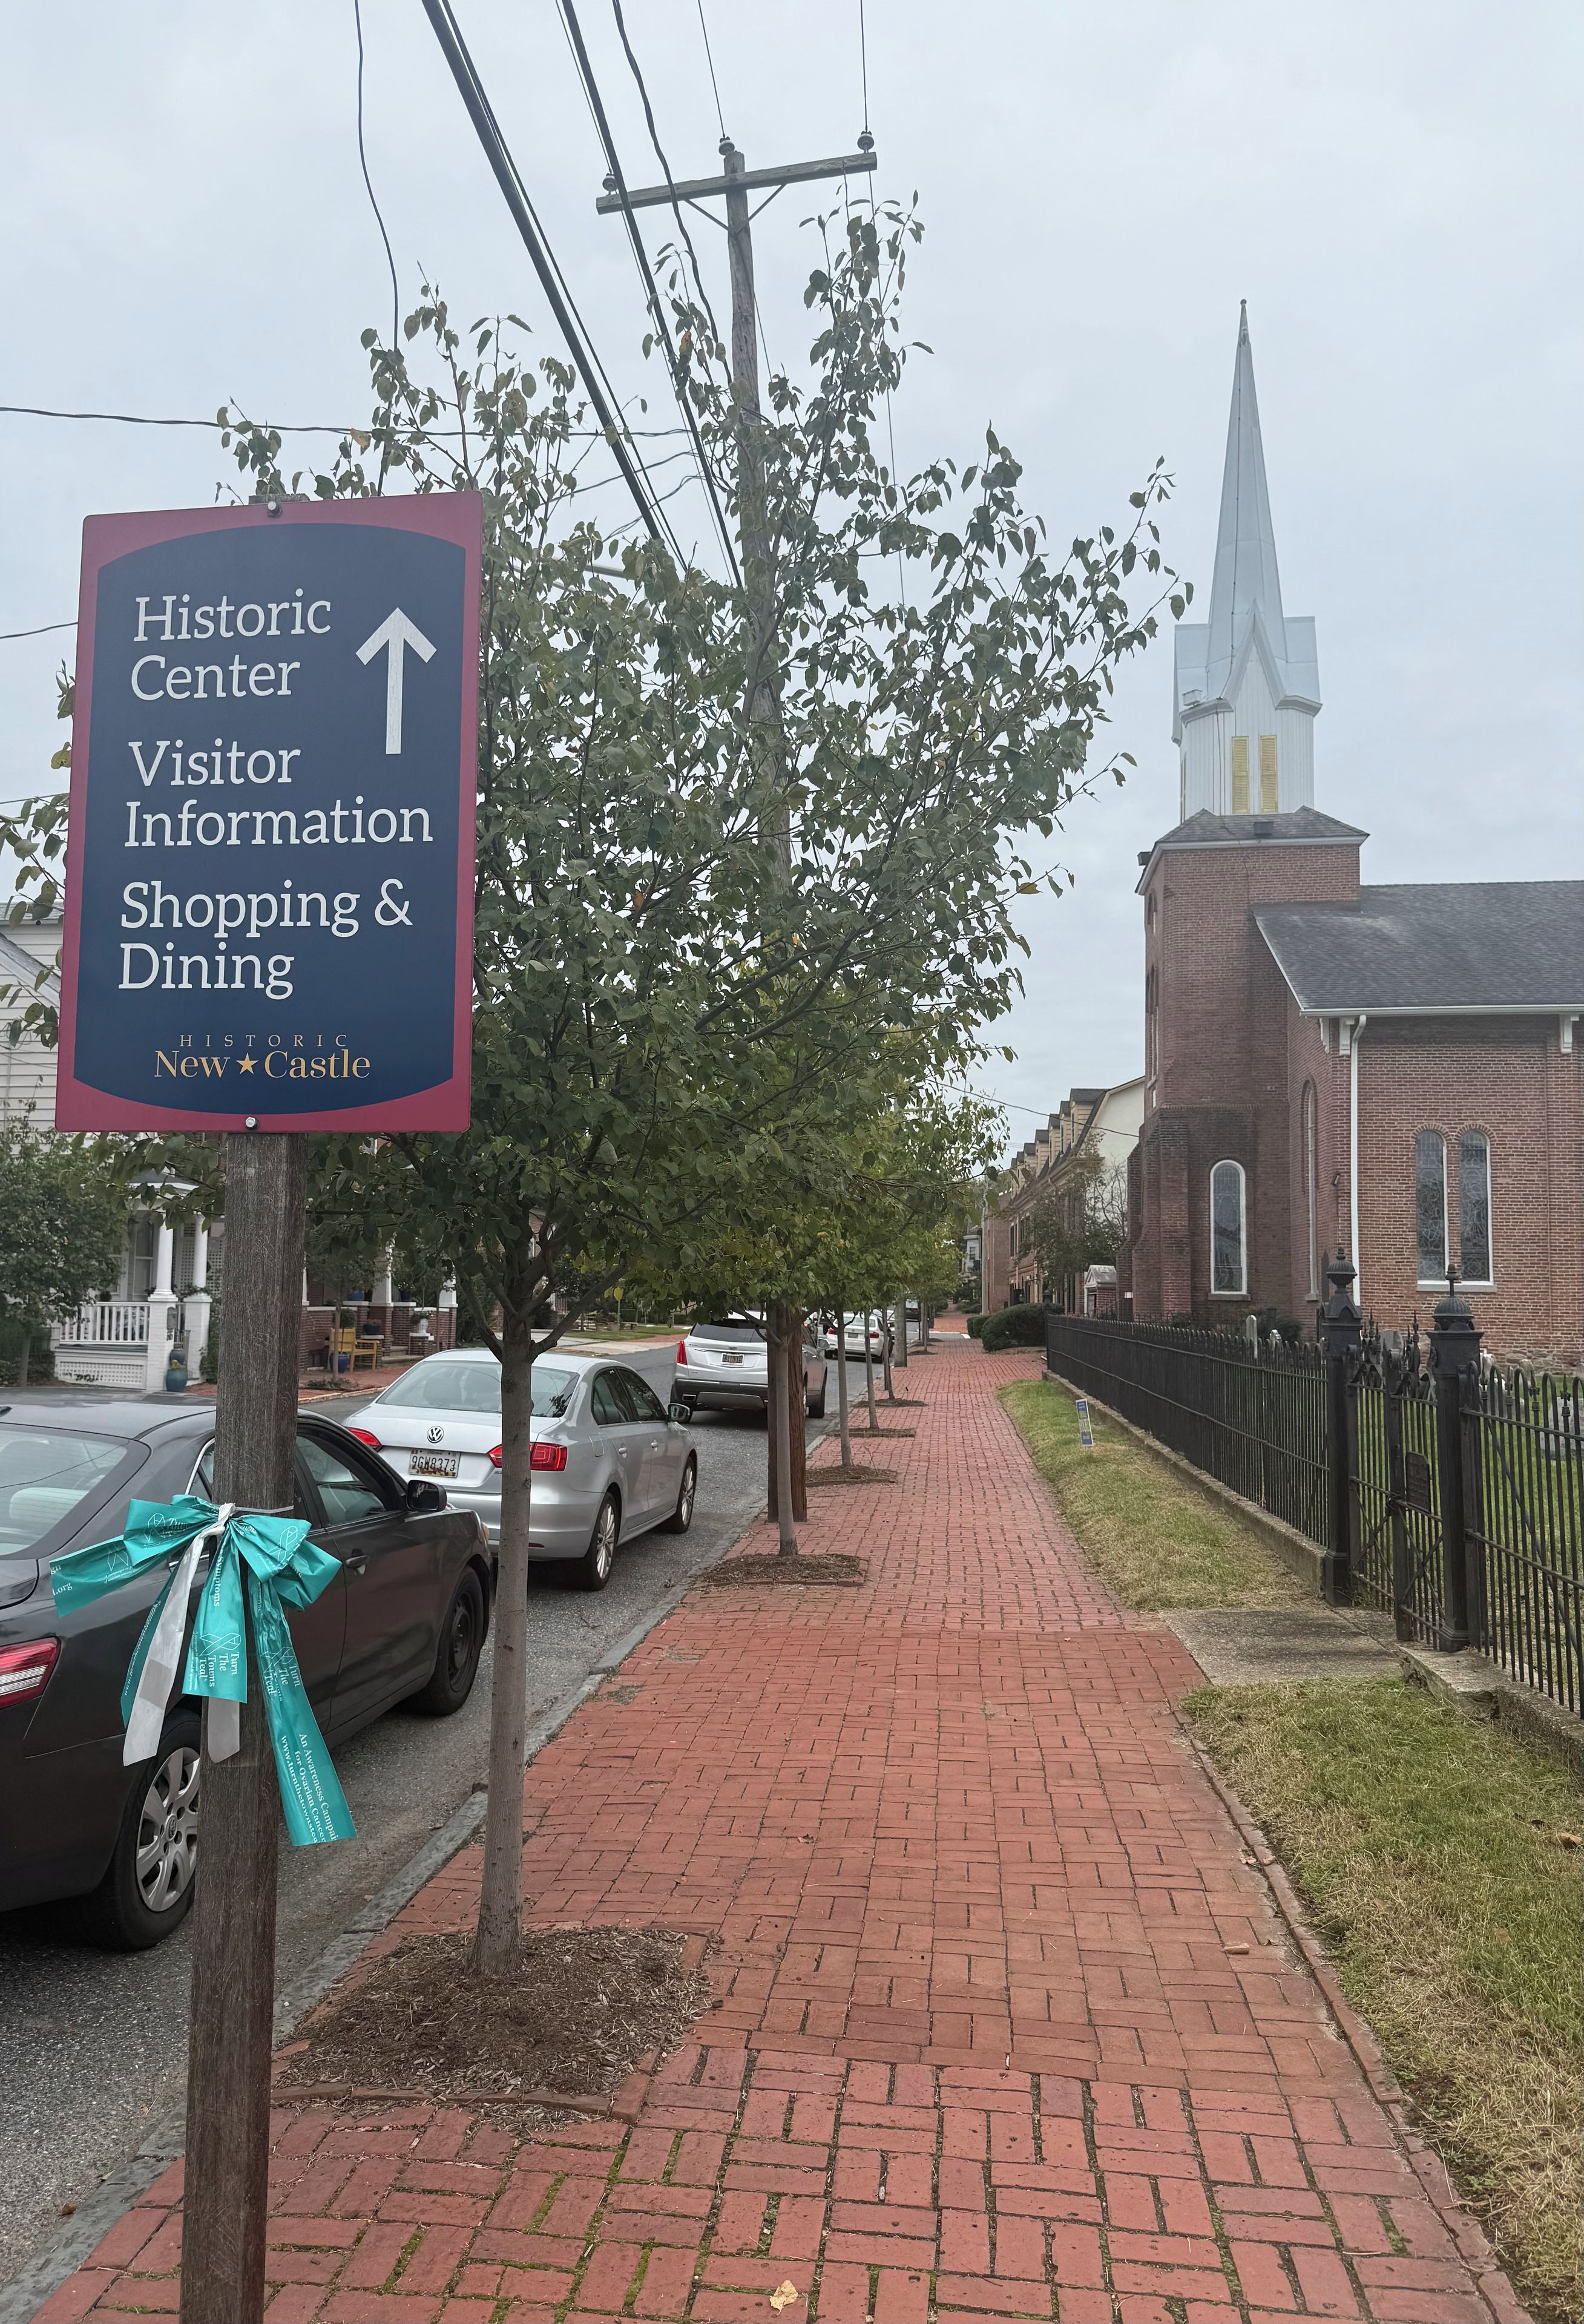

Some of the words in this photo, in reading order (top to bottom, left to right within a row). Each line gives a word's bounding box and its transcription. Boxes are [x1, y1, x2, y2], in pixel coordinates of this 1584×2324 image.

[134, 588, 332, 642] Historic
[131, 654, 301, 701] Center
[128, 738, 301, 787] Visitor
[124, 795, 433, 847] Information
[121, 879, 361, 938] Shopping
[375, 878, 413, 926] &
[118, 941, 295, 1000] Dining
[179, 1034, 347, 1047] HISTORIC
[154, 1050, 231, 1078] New
[265, 1049, 370, 1078] Castle
[412, 1455, 456, 1472] 9GW8373
[214, 1557, 224, 1607] Symptoms
[199, 1657, 208, 1679] Teal
[208, 1655, 217, 1687] Towns
[219, 1653, 229, 1672] The
[231, 1651, 240, 1675] Turn
[278, 1667, 289, 1686] The
[289, 1663, 301, 1687] Turn
[264, 1672, 277, 1695] Teal
[298, 1734, 308, 1748] An
[304, 1750, 324, 1802] Awareness
[321, 1802, 339, 1841] Campai
[298, 1767, 315, 1807] Ovarian
[312, 1808, 326, 1842] Cancer
